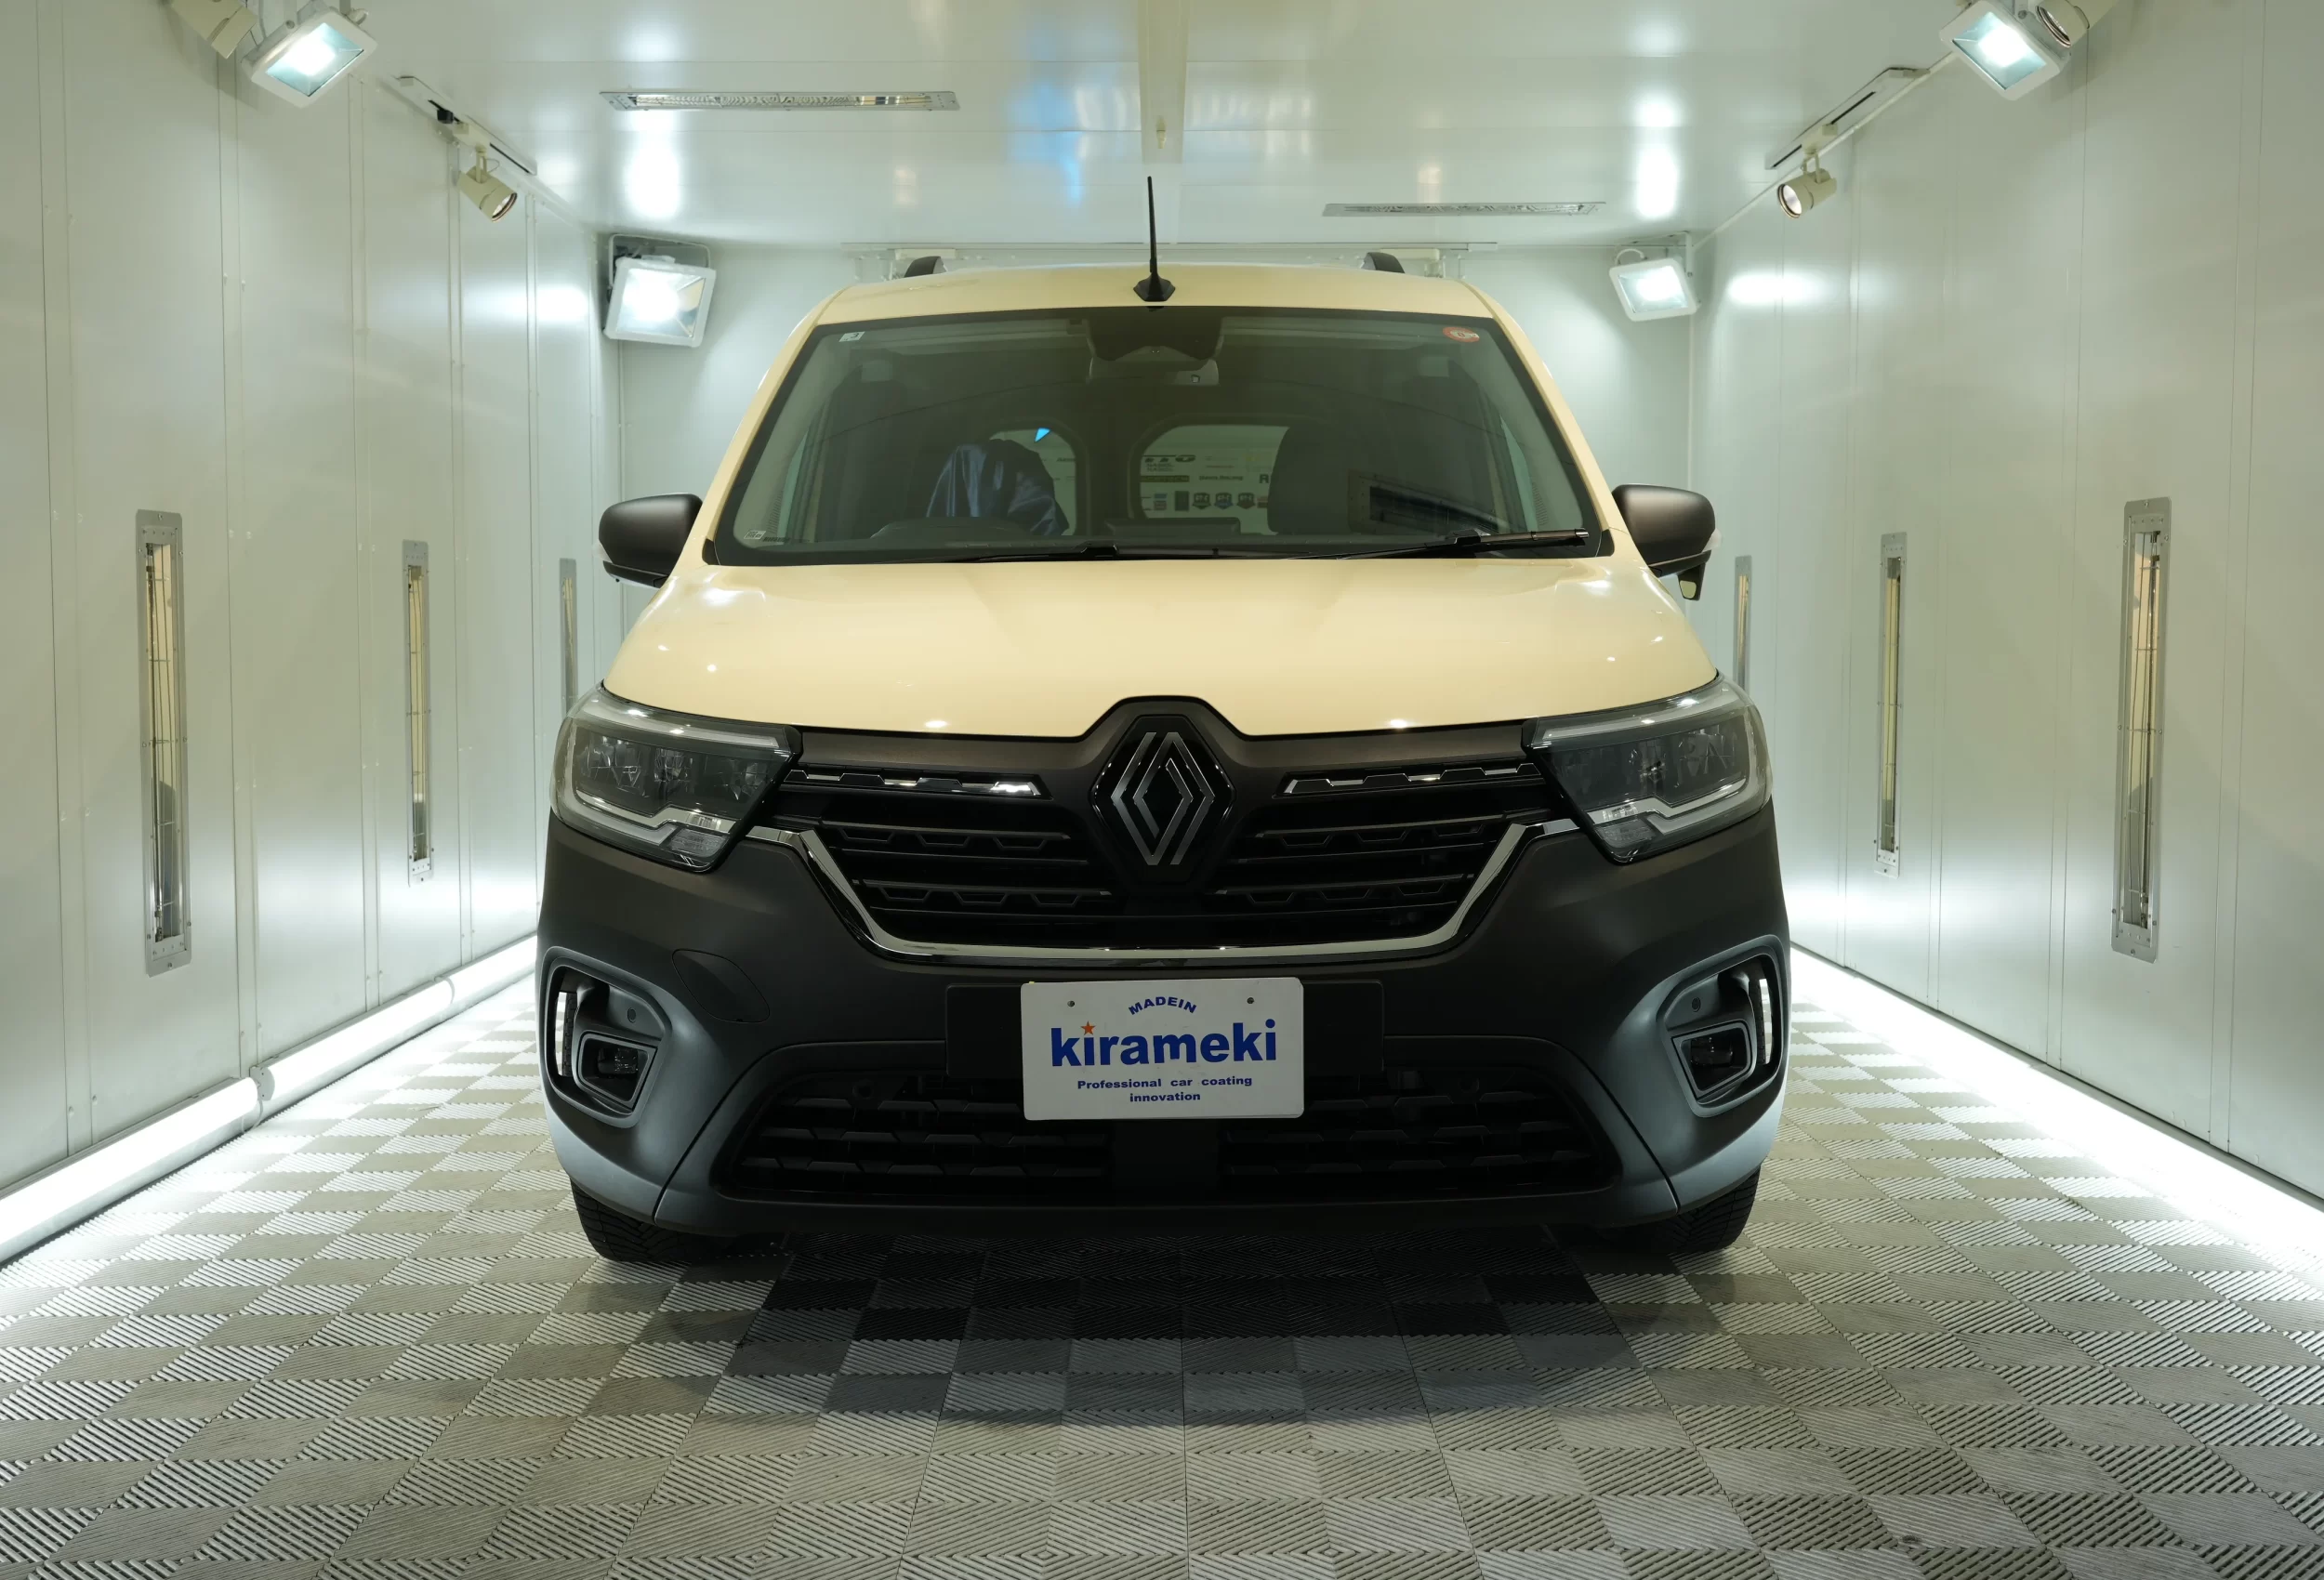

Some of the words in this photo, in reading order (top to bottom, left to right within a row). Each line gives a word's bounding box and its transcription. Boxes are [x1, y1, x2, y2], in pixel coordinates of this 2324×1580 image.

[1128, 996, 1197, 1015] MADEIN
[1050, 1019, 1277, 1067] kirameki
[1076, 1078, 1162, 1090] Professional
[1169, 1078, 1194, 1087] car
[1201, 1075, 1253, 1087] coating
[1129, 1091, 1201, 1103] innovation
